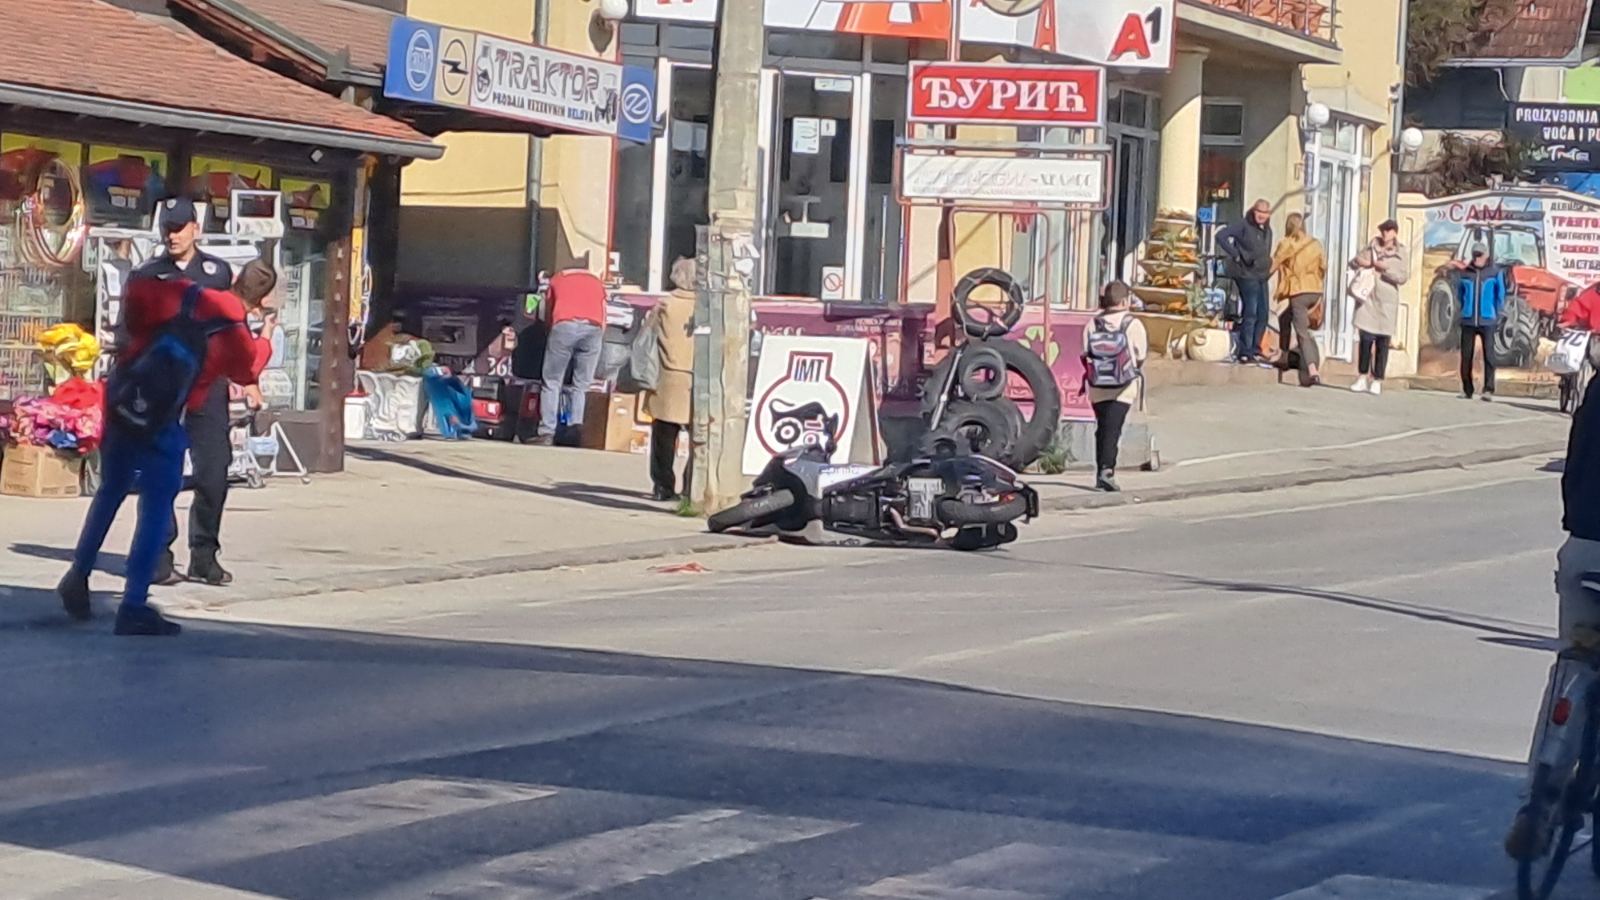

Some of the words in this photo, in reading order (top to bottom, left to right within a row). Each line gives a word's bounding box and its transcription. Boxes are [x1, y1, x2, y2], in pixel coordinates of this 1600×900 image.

[1106, 6, 1162, 62] A1
[494, 48, 600, 104] TRAKTOR
[921, 77, 1087, 113] ЂУРИЋ
[1516, 107, 1598, 124] PROIZVODNJA
[794, 359, 825, 382] IMT
